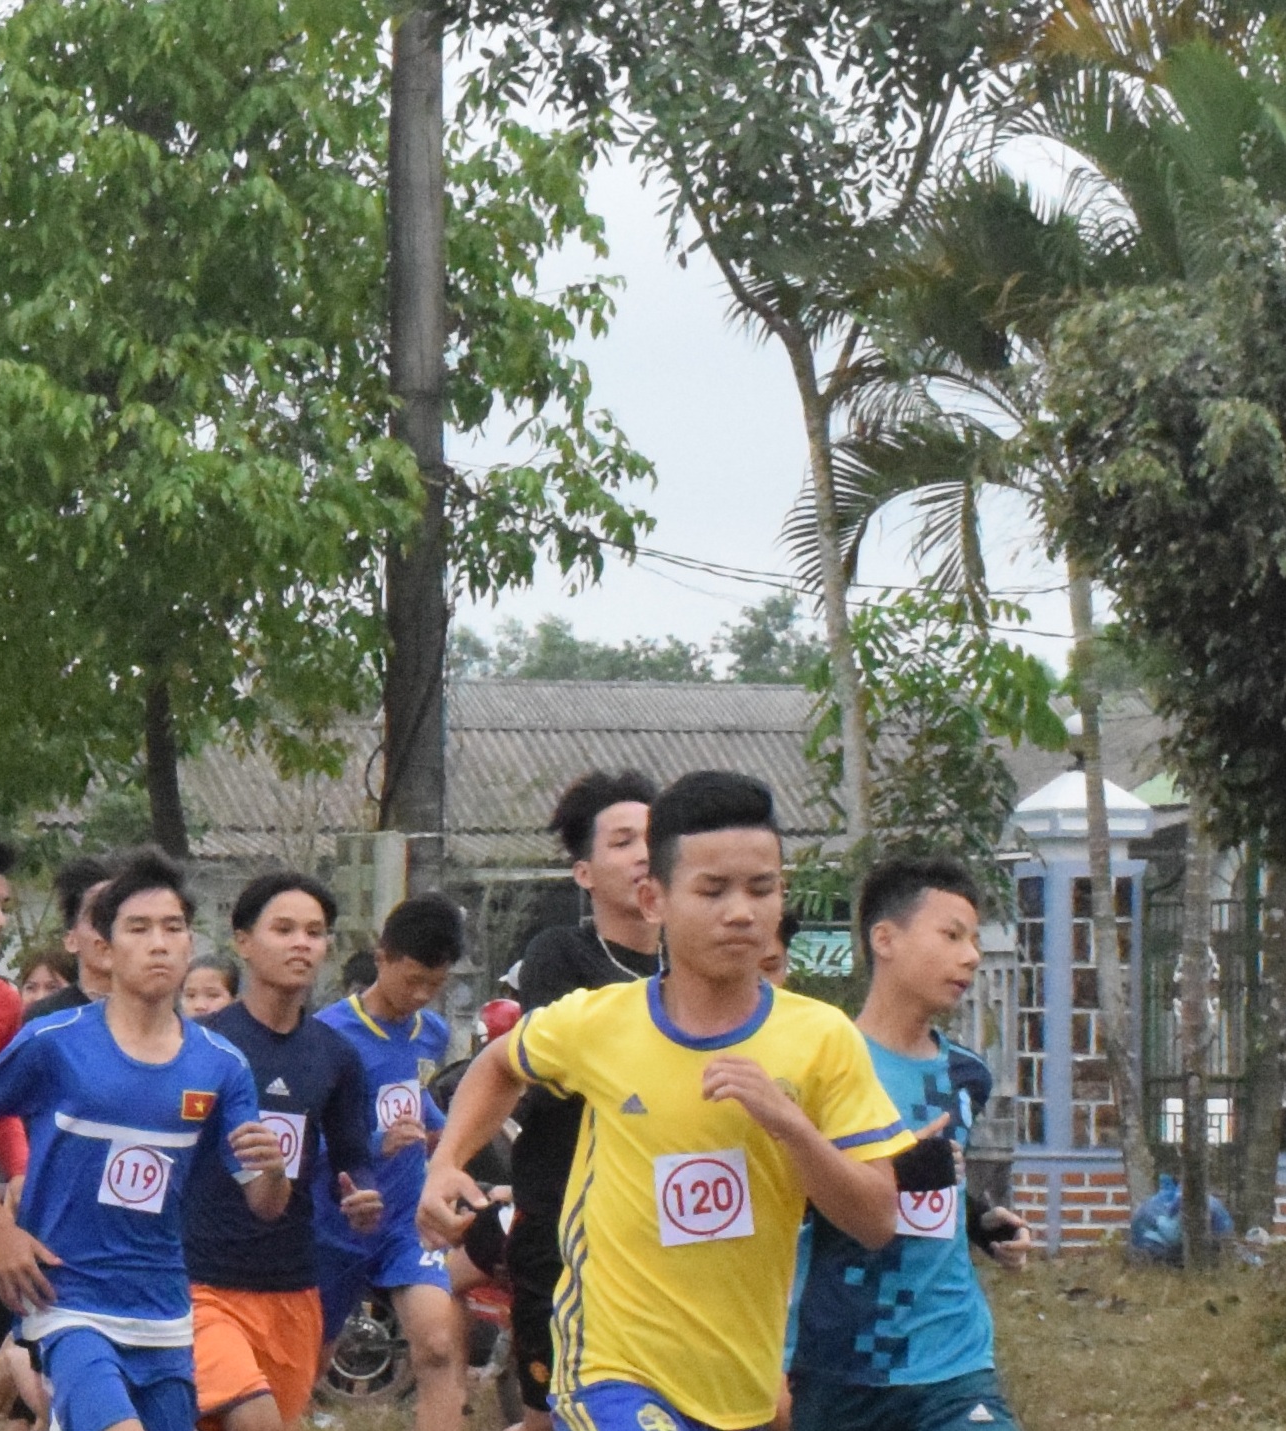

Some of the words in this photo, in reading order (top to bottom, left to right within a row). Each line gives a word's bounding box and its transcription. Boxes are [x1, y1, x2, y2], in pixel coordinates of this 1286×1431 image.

[382, 1098, 412, 1119] 134
[115, 1160, 157, 1190] 119
[672, 1177, 734, 1217] 120
